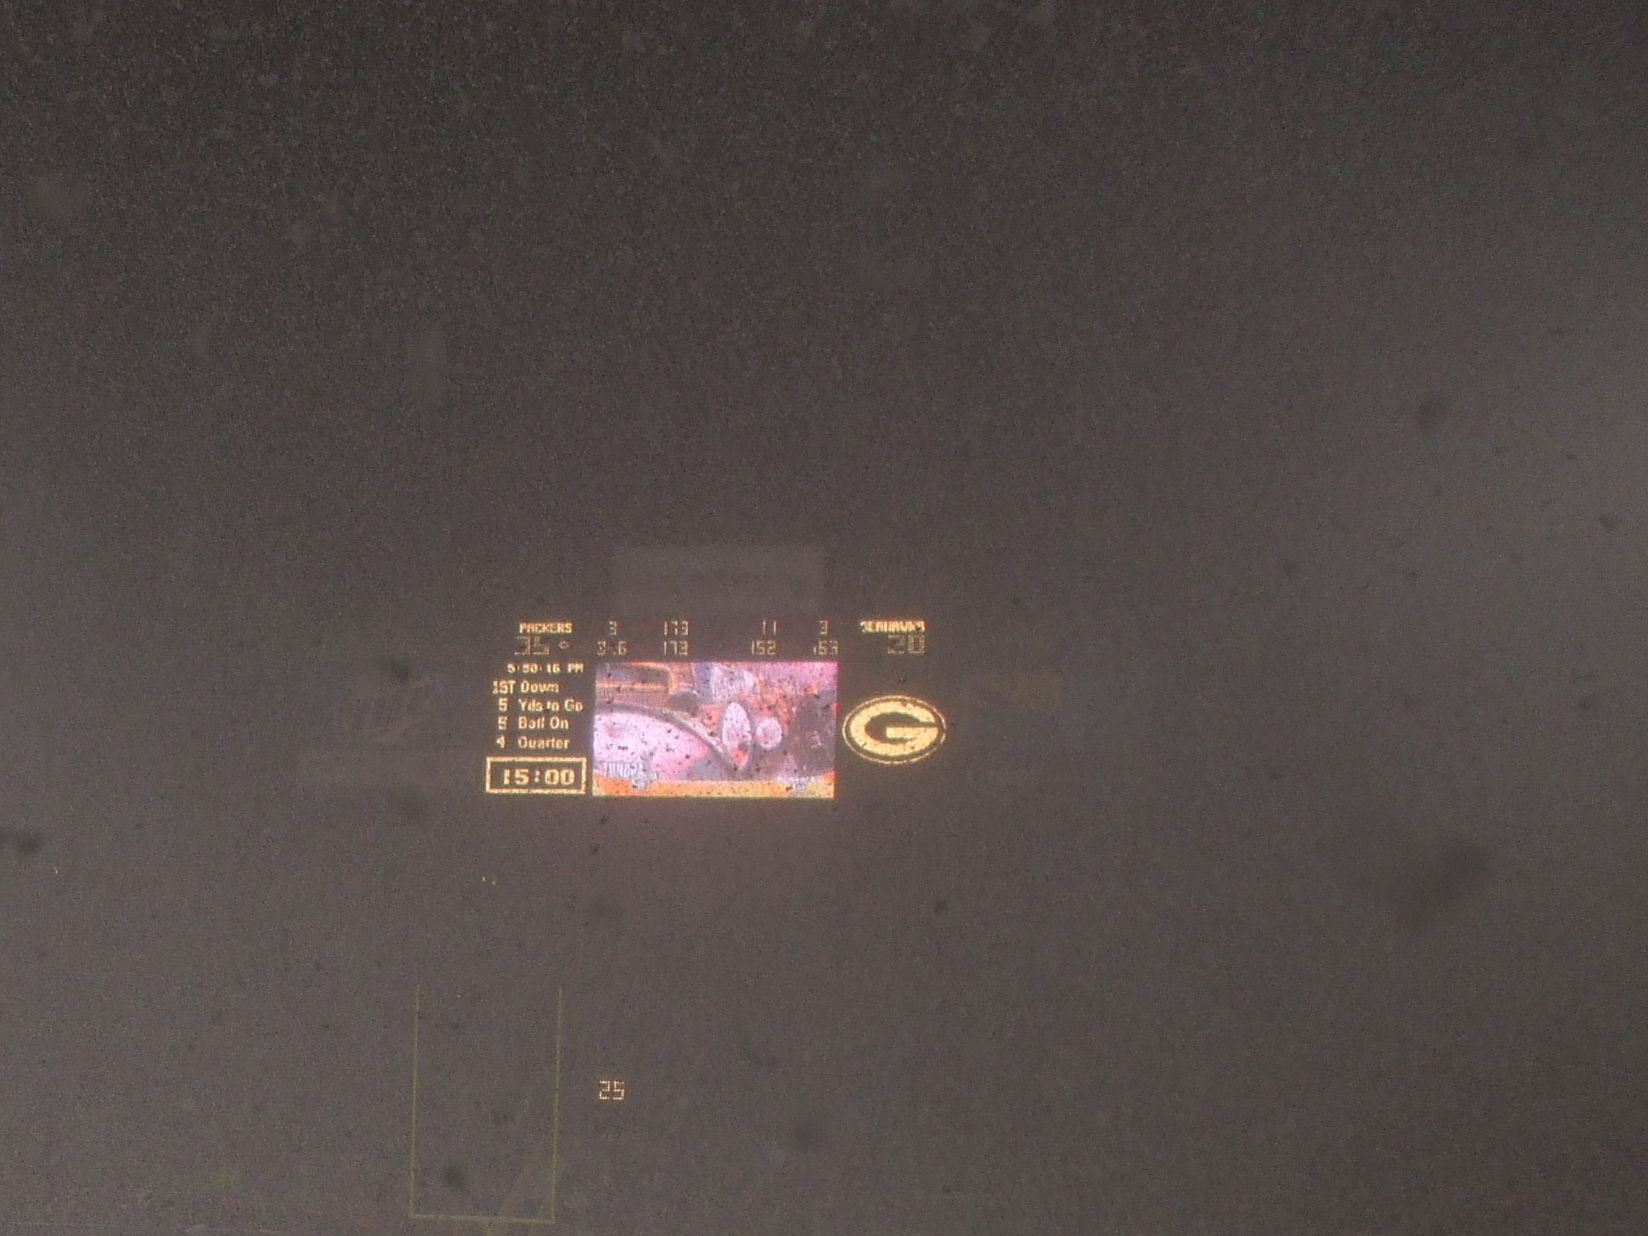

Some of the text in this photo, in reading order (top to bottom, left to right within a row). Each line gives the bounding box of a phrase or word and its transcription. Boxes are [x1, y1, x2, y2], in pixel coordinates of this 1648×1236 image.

[519, 622, 573, 634] PACKERS
[567, 662, 584, 674] PM
[520, 680, 559, 694] Down
[499, 697, 583, 712] 5 Yds to Go
[518, 716, 545, 729] Ball
[550, 716, 569, 729] On
[518, 735, 570, 749] Quarter
[503, 769, 575, 786] 15:00
[599, 1080, 626, 1100] 25
